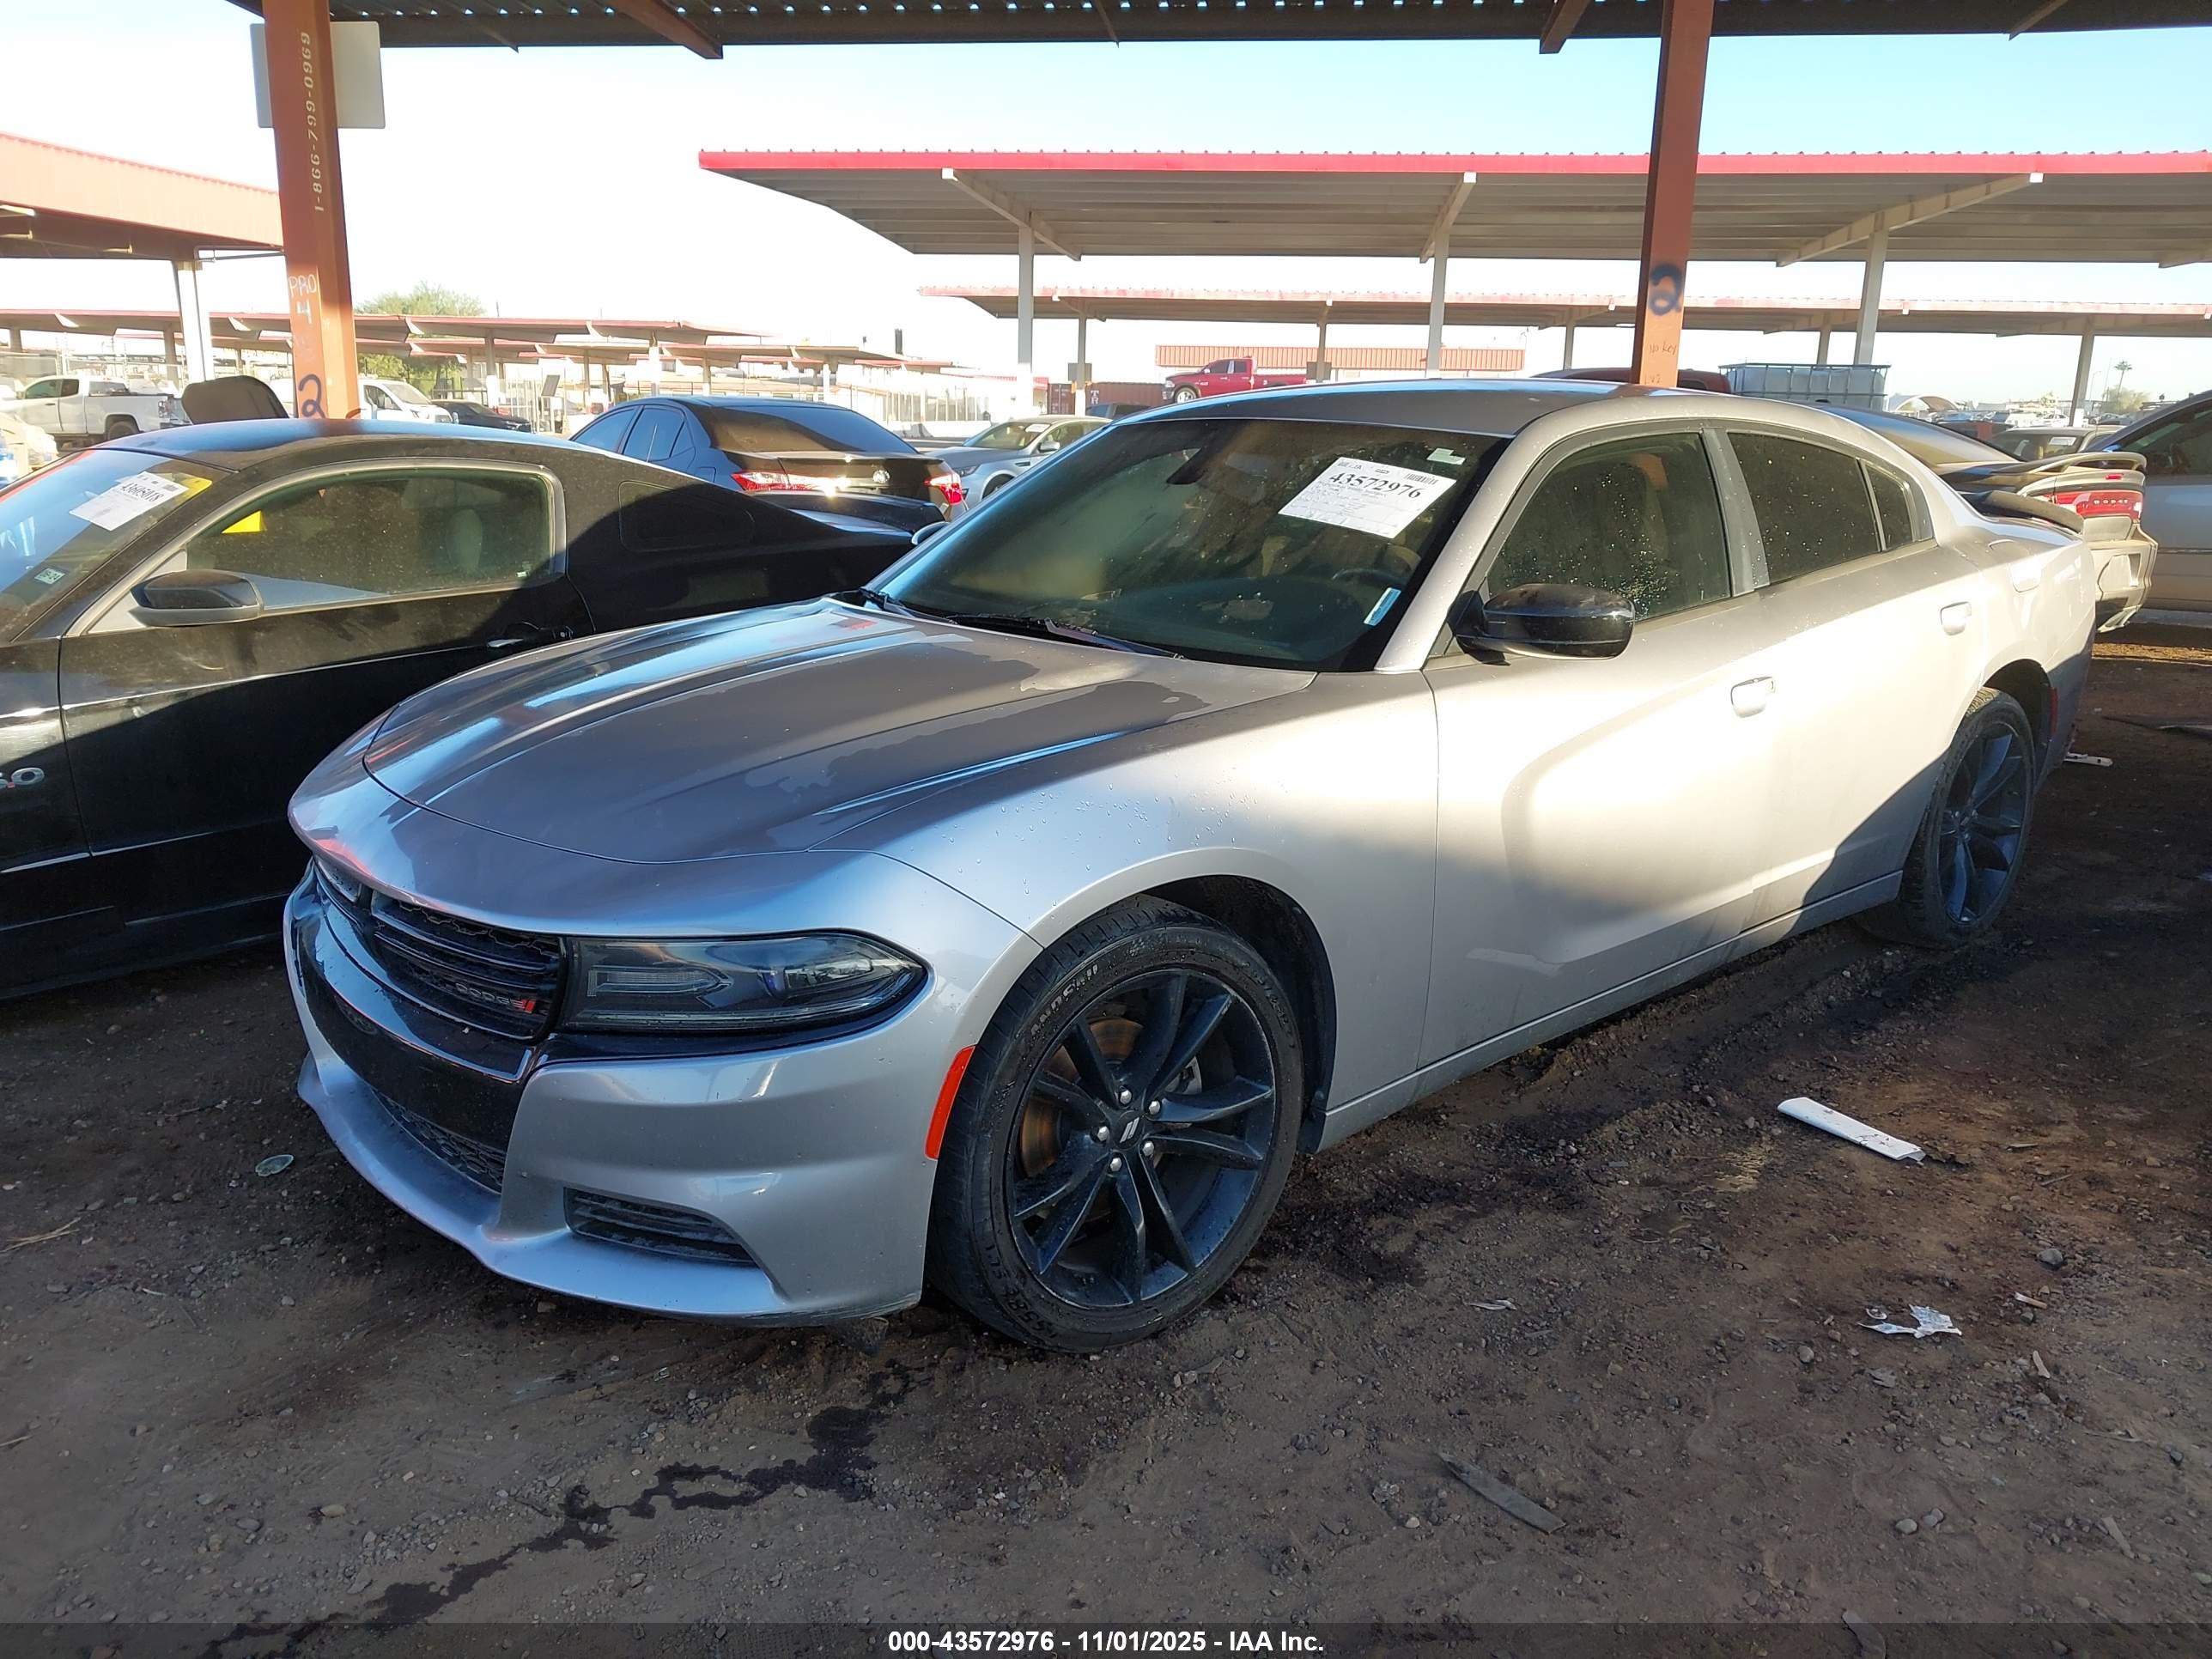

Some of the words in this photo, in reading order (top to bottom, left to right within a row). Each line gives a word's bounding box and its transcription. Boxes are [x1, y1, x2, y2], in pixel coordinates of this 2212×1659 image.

[300, 32, 325, 212] 1-866-799-0969
[296, 298, 312, 325] 4
[1649, 264, 1683, 315] 2
[298, 374, 327, 418] 2
[1329, 472, 1426, 499] 43572976
